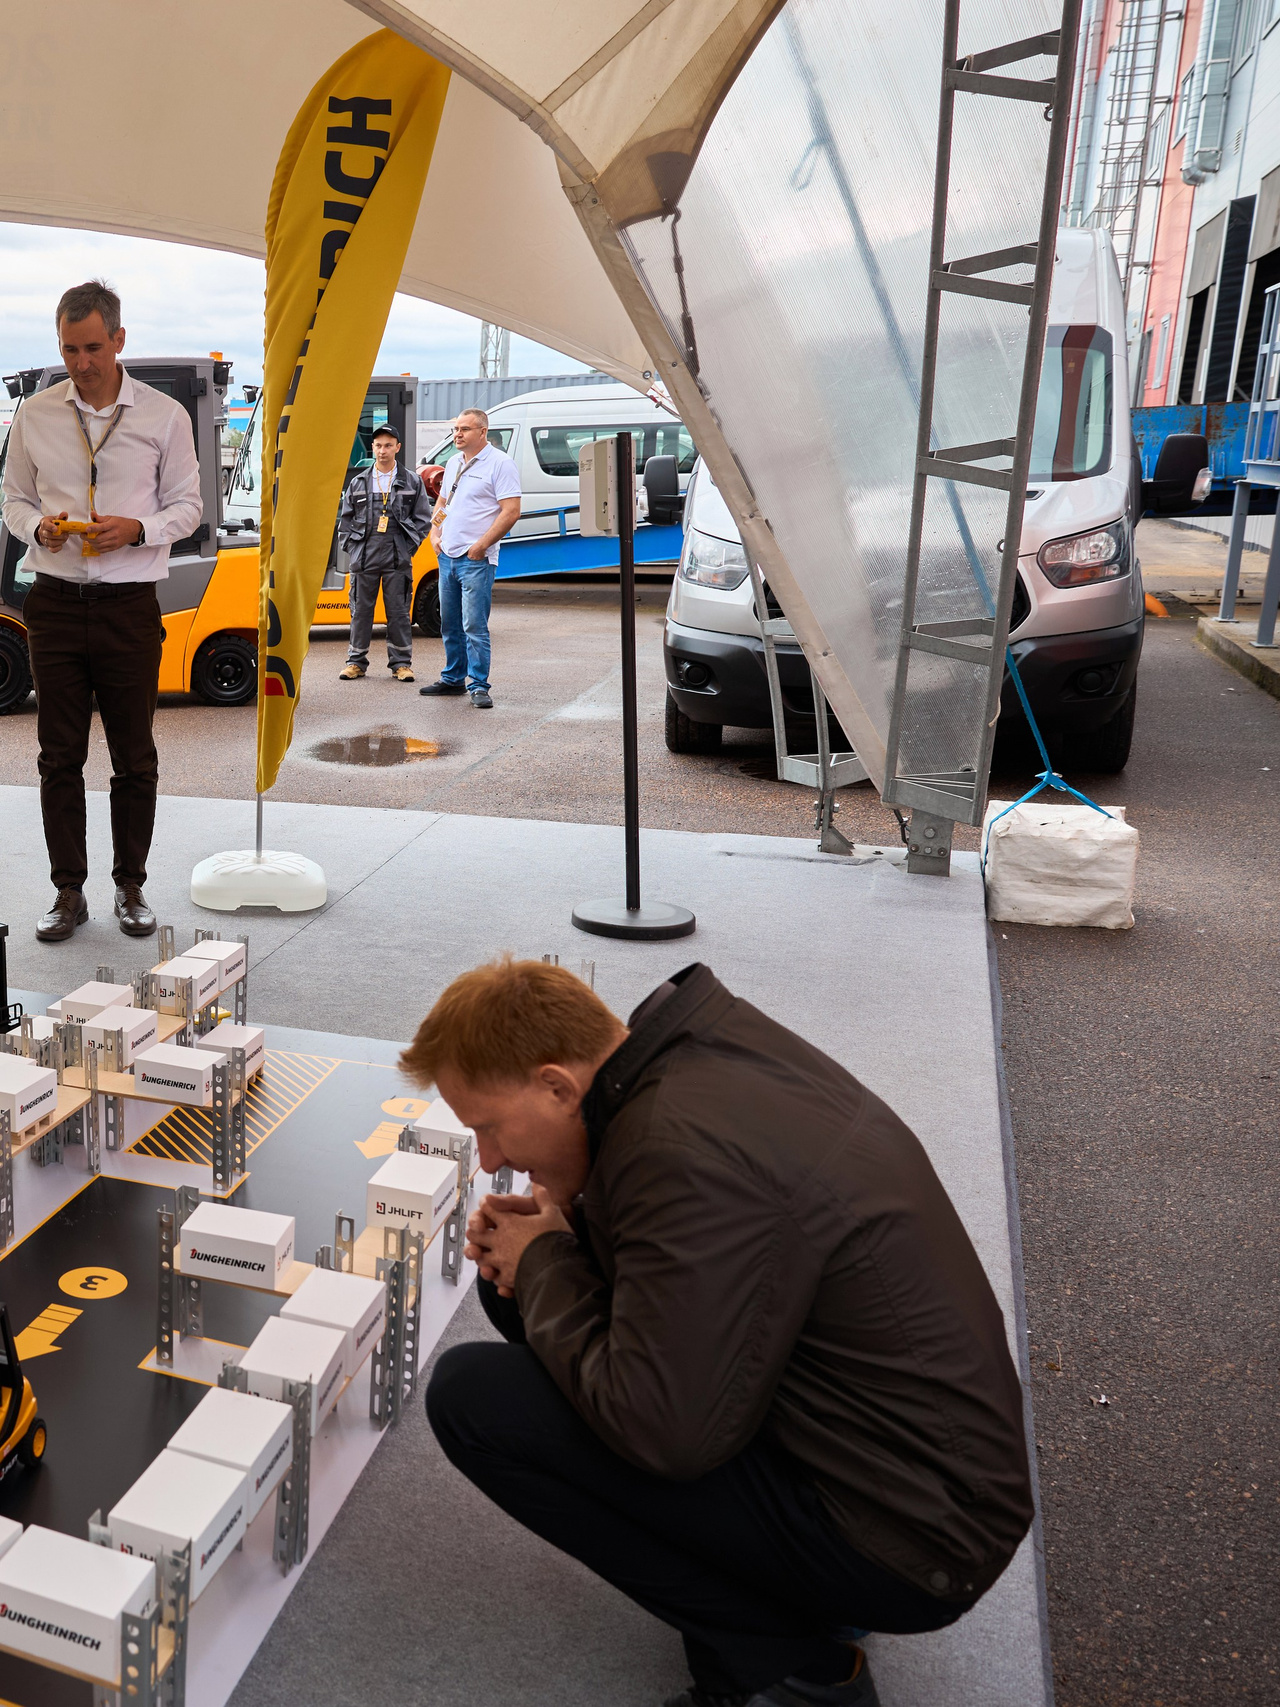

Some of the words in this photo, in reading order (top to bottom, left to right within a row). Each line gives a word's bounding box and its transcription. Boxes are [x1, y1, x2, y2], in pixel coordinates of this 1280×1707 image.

[141, 1072, 197, 1091] JUNGHEINRICH
[19, 1088, 54, 1116] JUNGHEINRICH
[388, 1206, 423, 1220] JHLIFT
[190, 1248, 266, 1273] JUNGHEINRICH
[79, 1275, 109, 1291] 3
[0, 1603, 102, 1652] JUNGHEINRICH
